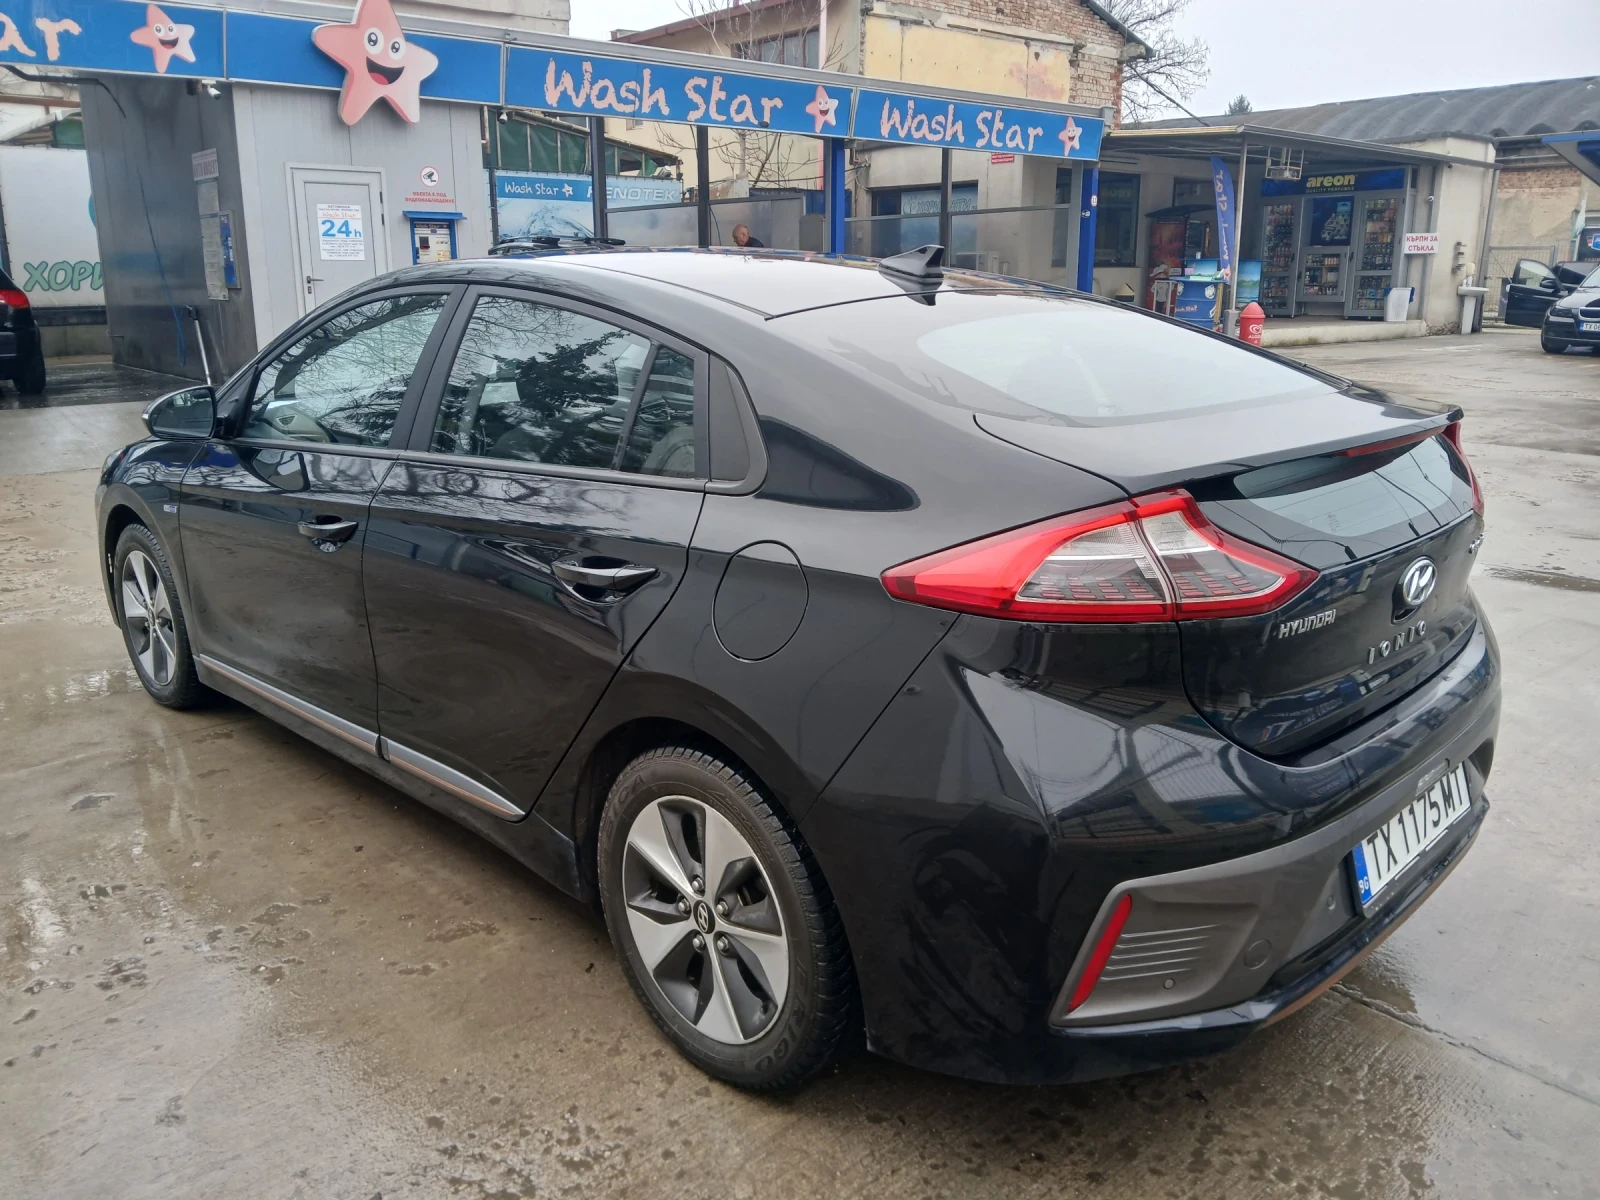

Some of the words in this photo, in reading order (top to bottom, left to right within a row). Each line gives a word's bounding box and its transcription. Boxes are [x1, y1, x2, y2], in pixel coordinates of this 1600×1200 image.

[544, 58, 670, 116] Wash
[684, 75, 783, 125] Star
[880, 97, 965, 144] Wash
[975, 109, 1043, 152] Star
[504, 181, 533, 194] Wash
[535, 183, 559, 195] Star
[1306, 174, 1355, 188] areon
[321, 219, 362, 238] 24h
[1279, 609, 1337, 639] HYUNDAI
[1367, 822, 1398, 880] TX
[1398, 786, 1441, 855] 1175
[1440, 766, 1463, 819] MT
